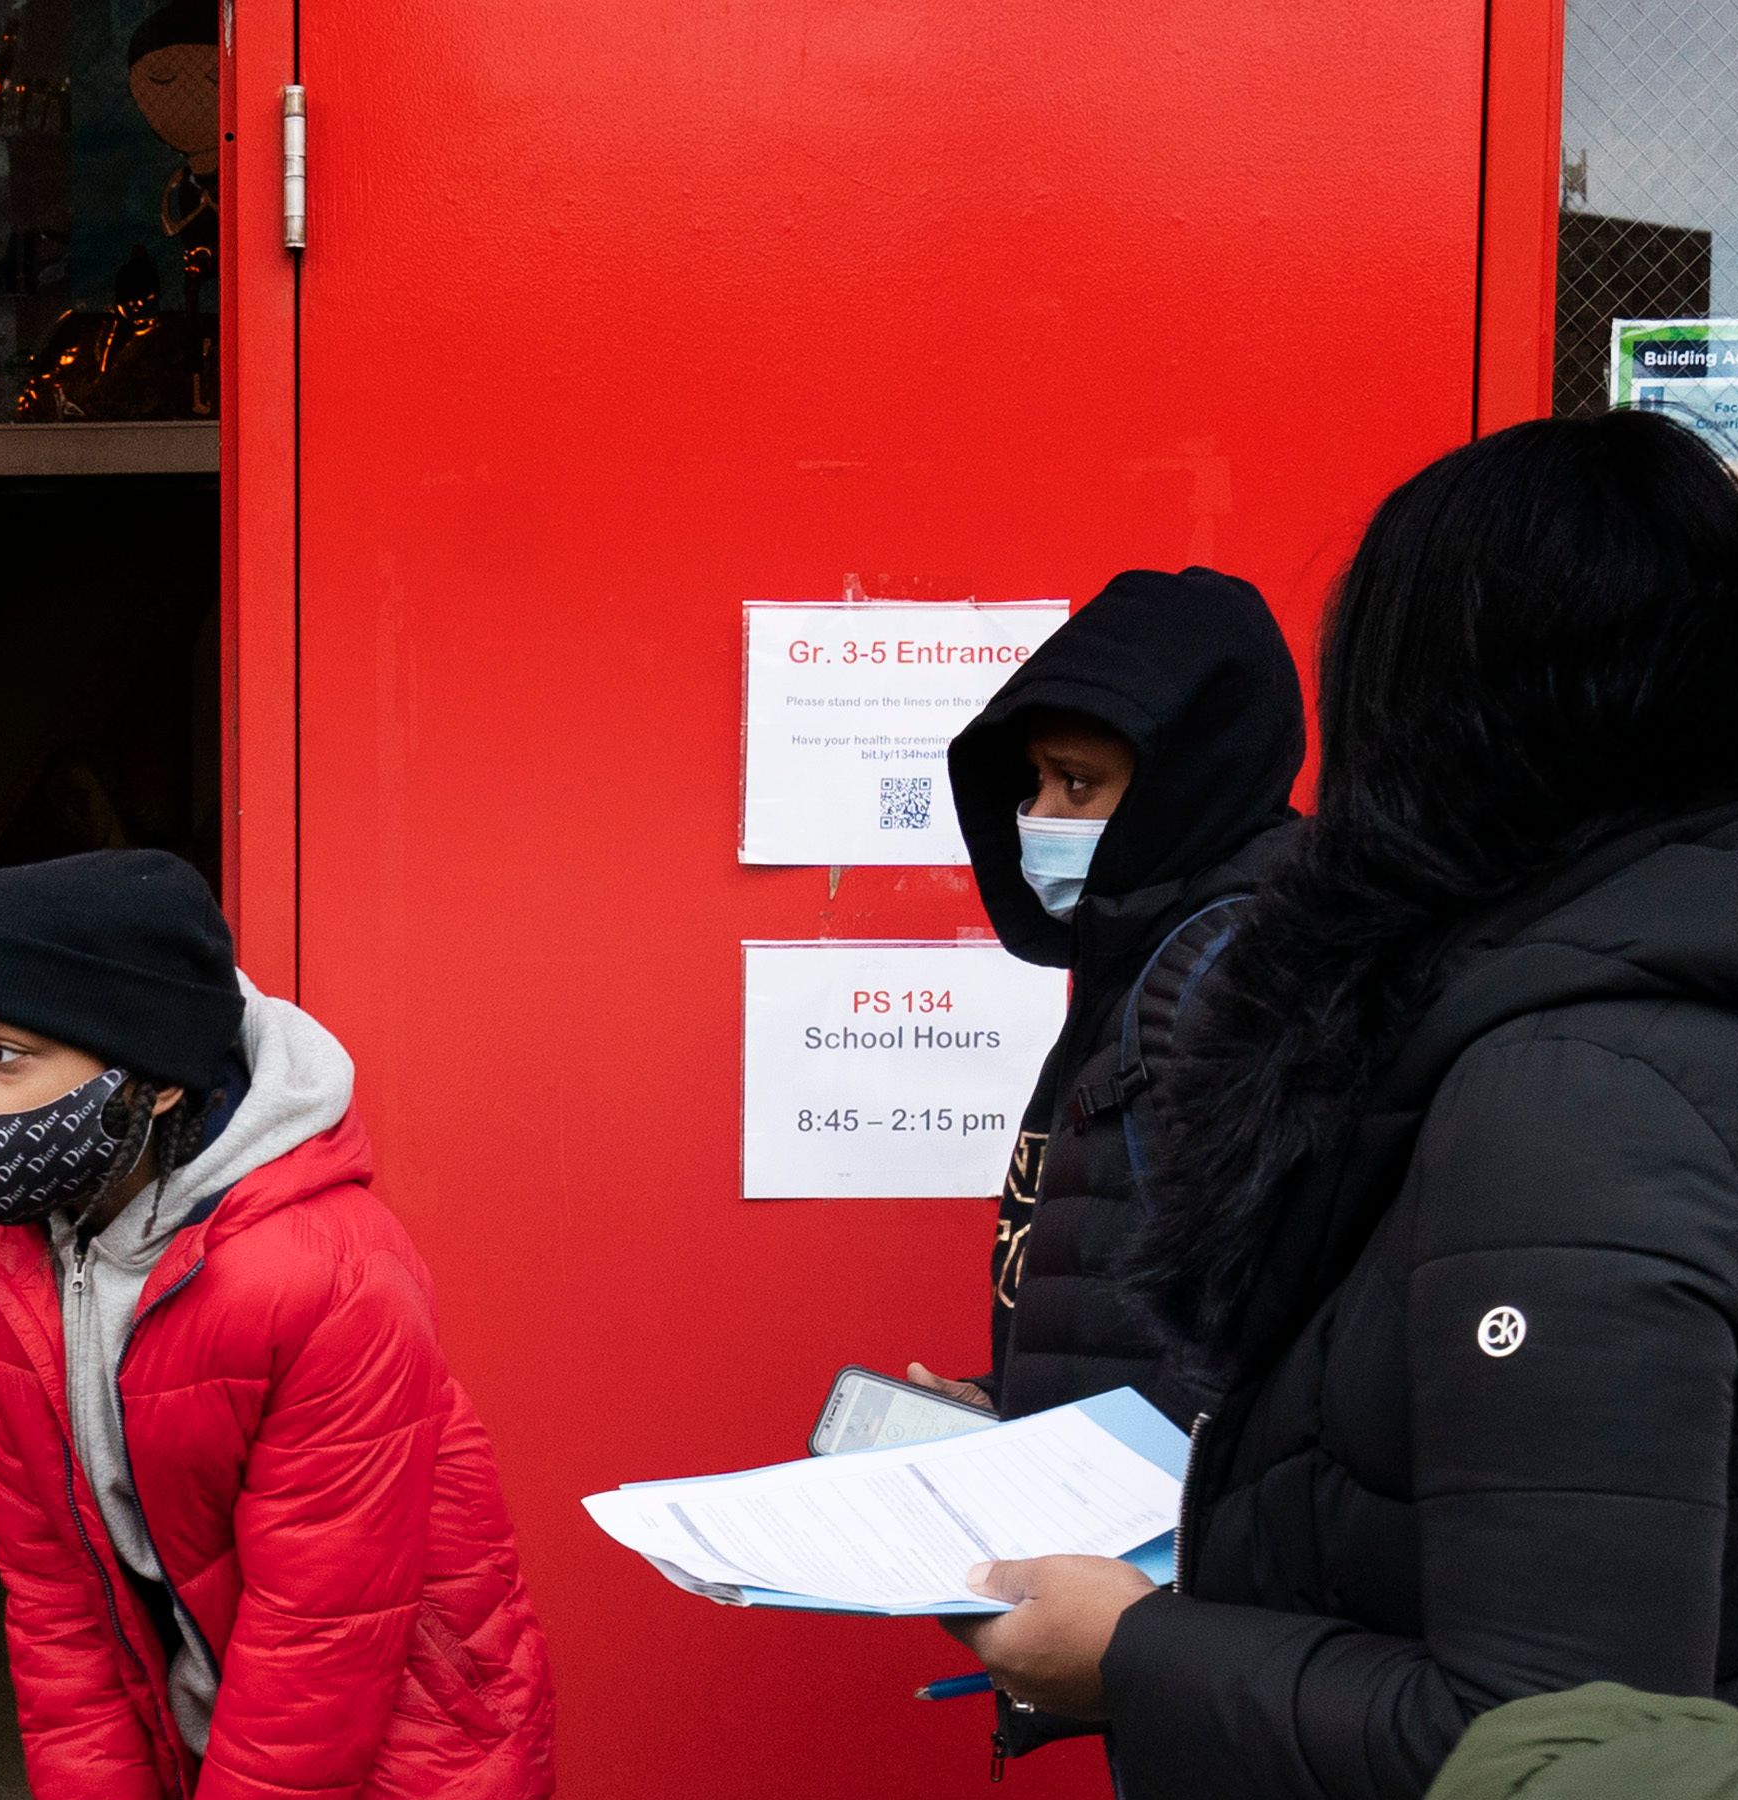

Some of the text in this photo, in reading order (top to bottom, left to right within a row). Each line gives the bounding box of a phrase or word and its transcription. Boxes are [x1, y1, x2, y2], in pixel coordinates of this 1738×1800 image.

[1644, 350, 1717, 367] Building
[788, 640, 1031, 664] Gr. 3-5 Entrance
[785, 696, 825, 708] Please
[828, 696, 861, 708] stand
[864, 698, 879, 707] on
[882, 696, 900, 708] the
[903, 696, 932, 708] lines
[934, 698, 950, 707] on
[953, 696, 972, 708] the
[791, 735, 822, 745] Have
[824, 737, 851, 747] your
[854, 735, 891, 745] health
[861, 749, 948, 762] bit.ly/134healt
[853, 990, 954, 1013] PS 134
[804, 1026, 1001, 1050] School Hours
[25, 1109, 61, 1142] Dior
[61, 1098, 97, 1133] Dior
[797, 1109, 860, 1132] 8:45
[891, 1109, 953, 1132] 2:15
[962, 1113, 1005, 1136] pm
[26, 1142, 60, 1173] Dior
[61, 1136, 95, 1168] Dior
[29, 1177, 60, 1202] Dior
